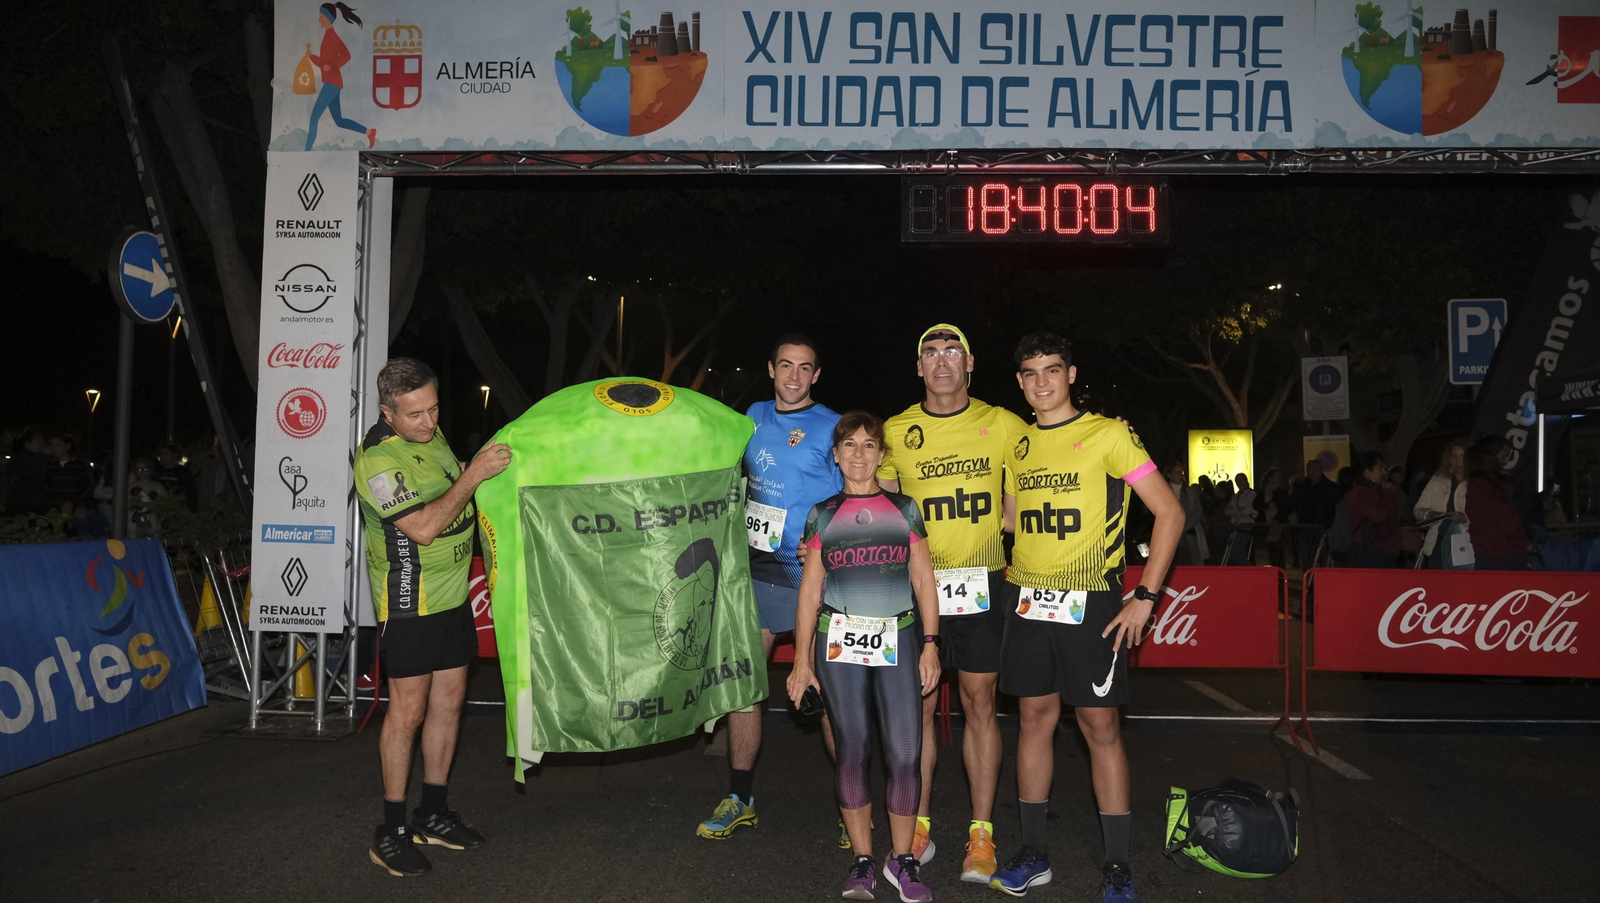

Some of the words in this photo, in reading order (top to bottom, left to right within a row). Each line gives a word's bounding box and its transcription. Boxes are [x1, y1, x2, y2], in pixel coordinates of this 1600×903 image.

[743, 10, 832, 64] XIV
[848, 11, 961, 65] SAN
[979, 12, 1285, 69] SILVESTRE
[435, 57, 537, 82] ALMERÍA
[459, 81, 512, 95] CIUDAD
[744, 75, 942, 128] CIUDAD
[960, 75, 1030, 128] DE
[1047, 68, 1294, 132] ALMERÍA
[966, 183, 1156, 235] 18:40:04
[275, 219, 343, 230] RENAULT
[275, 230, 297, 239] SYRSA
[297, 230, 342, 239] AUTOMOCION
[274, 284, 337, 293] NISSAN
[279, 315, 335, 324] andalmotor.es
[1457, 306, 1490, 353] P
[267, 341, 346, 370] Coca-Cola
[1459, 364, 1489, 375] PARKI
[932, 453, 959, 464] Deportivo
[918, 457, 991, 481] SPORTGYM
[1018, 472, 1081, 492] SPORTGYM
[922, 487, 992, 524] mtp
[571, 513, 622, 535] C.D.
[746, 515, 770, 535] 961
[1020, 502, 1082, 540] mtp
[264, 526, 313, 541] Almericar
[397, 537, 409, 546] EL
[398, 547, 410, 557] DE
[827, 545, 908, 570] SPORTGYM
[942, 582, 968, 599] 14
[1033, 589, 1071, 604] 657
[259, 604, 327, 617] RENAULT
[1378, 587, 1590, 652] Coca-Cola
[259, 616, 280, 626] SYRSA
[281, 616, 326, 627] AUTOMOCION
[843, 631, 882, 650] 540
[0, 632, 171, 735] ortes
[616, 696, 673, 722] DEL
